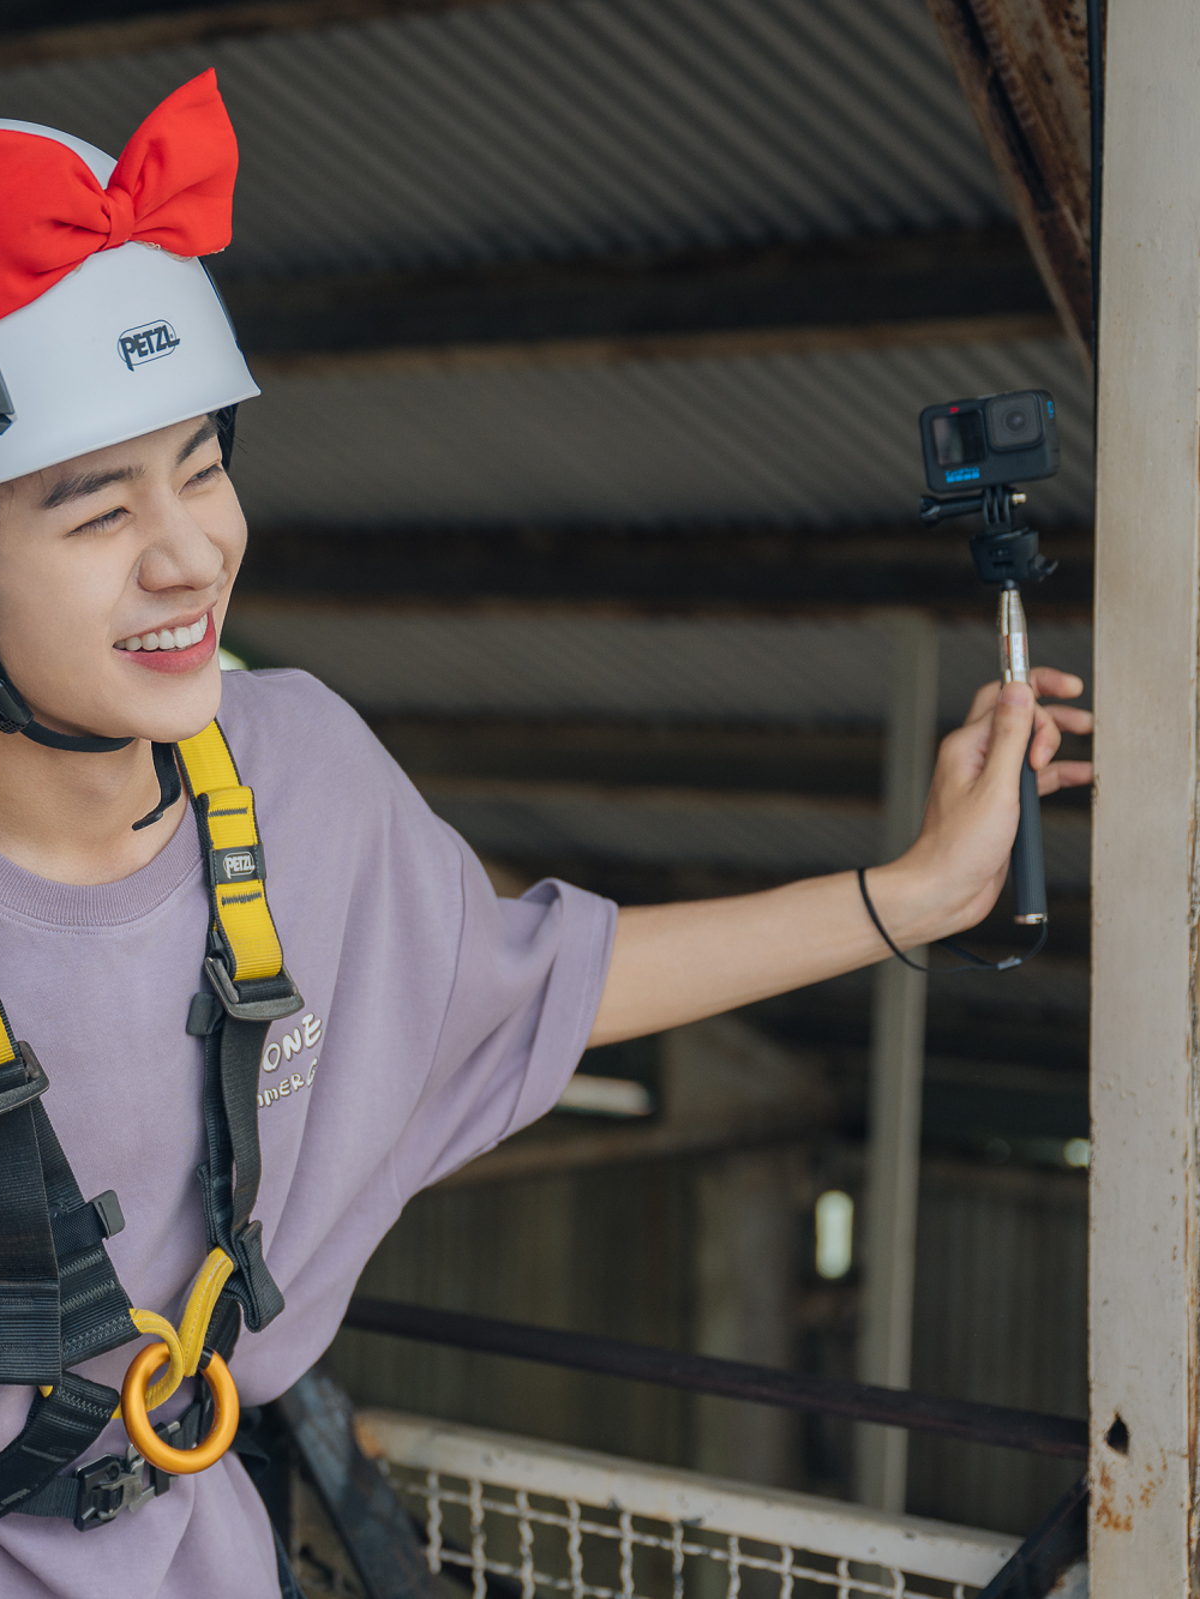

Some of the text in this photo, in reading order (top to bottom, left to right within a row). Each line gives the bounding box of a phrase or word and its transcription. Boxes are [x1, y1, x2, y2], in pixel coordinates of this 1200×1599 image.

[119, 324, 180, 372] PETZL
[223, 855, 256, 880] PETZL
[262, 1013, 322, 1073] ONE
